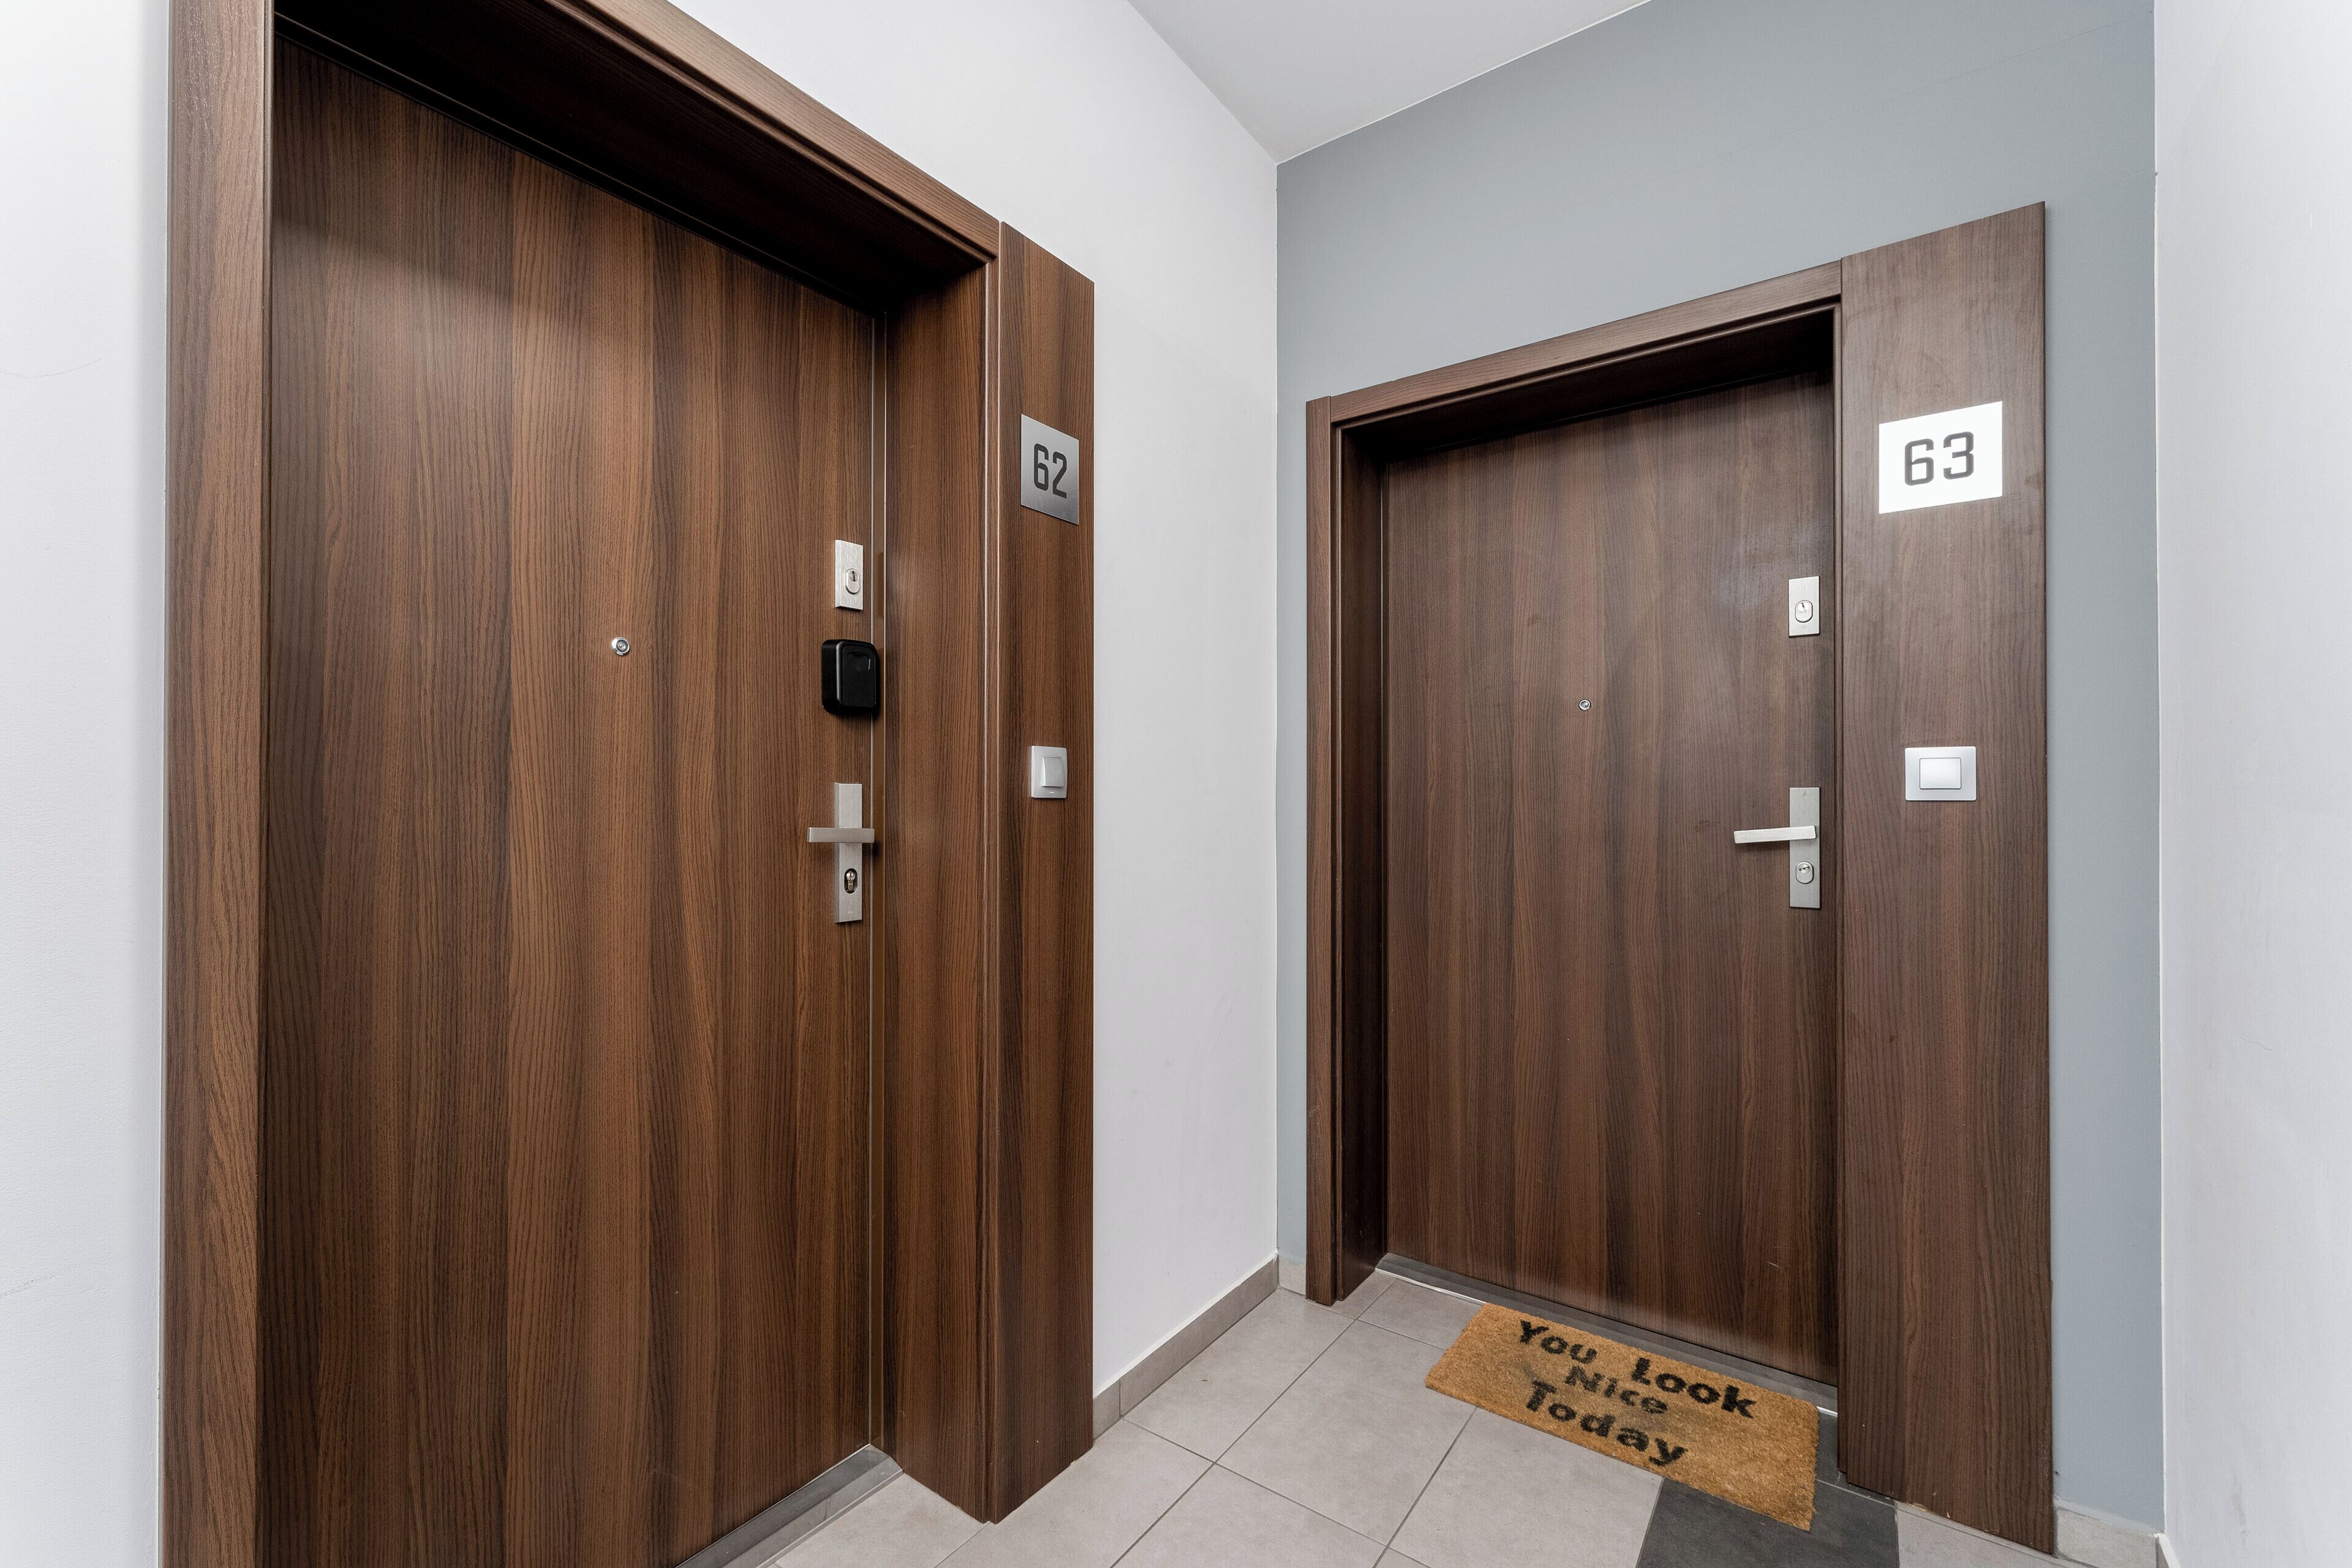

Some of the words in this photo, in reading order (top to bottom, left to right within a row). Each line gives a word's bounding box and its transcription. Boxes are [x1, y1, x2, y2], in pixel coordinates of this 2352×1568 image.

[1034, 443, 1067, 499] 62
[1904, 431, 1974, 486] 63
[1518, 1319, 1597, 1365] You
[1631, 1357, 1757, 1419] Look
[1564, 1365, 1668, 1415] Nice
[1525, 1380, 1689, 1468] Today
